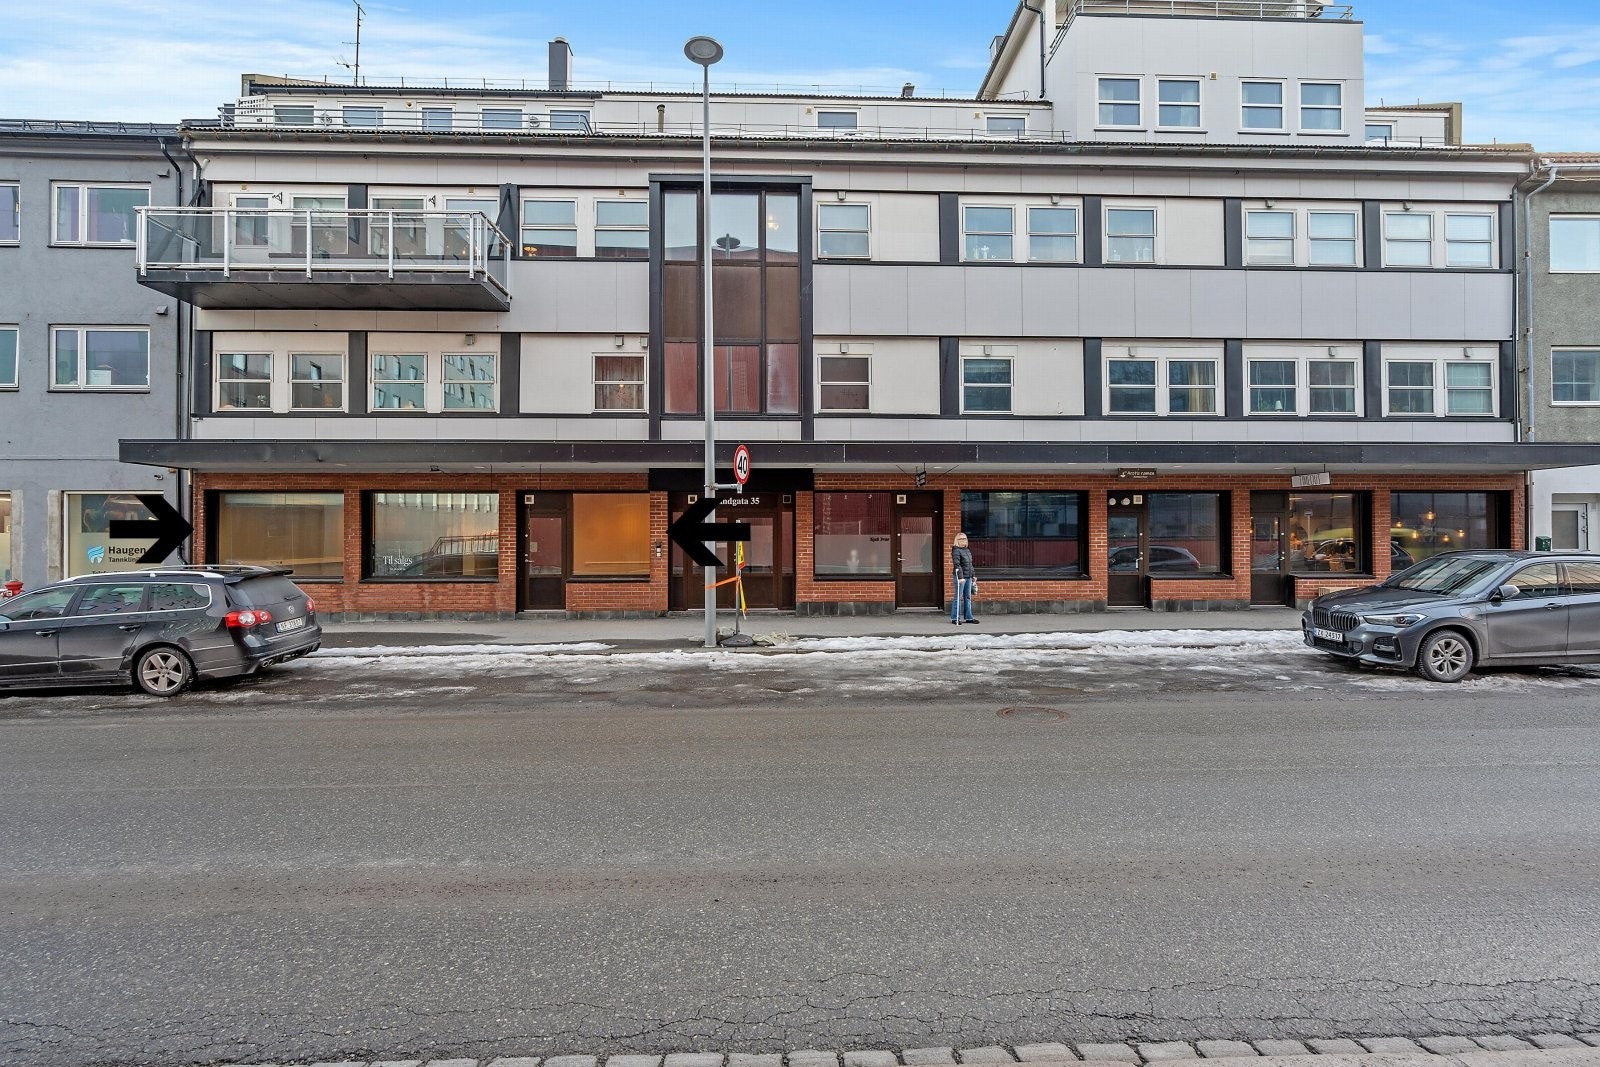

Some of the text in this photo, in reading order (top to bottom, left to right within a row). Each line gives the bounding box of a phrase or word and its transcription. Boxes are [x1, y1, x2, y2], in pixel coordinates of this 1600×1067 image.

[737, 455, 748, 474] 40
[720, 497, 760, 507] ndgata 35
[108, 546, 147, 556] Haugen
[382, 555, 413, 567] Til salgs
